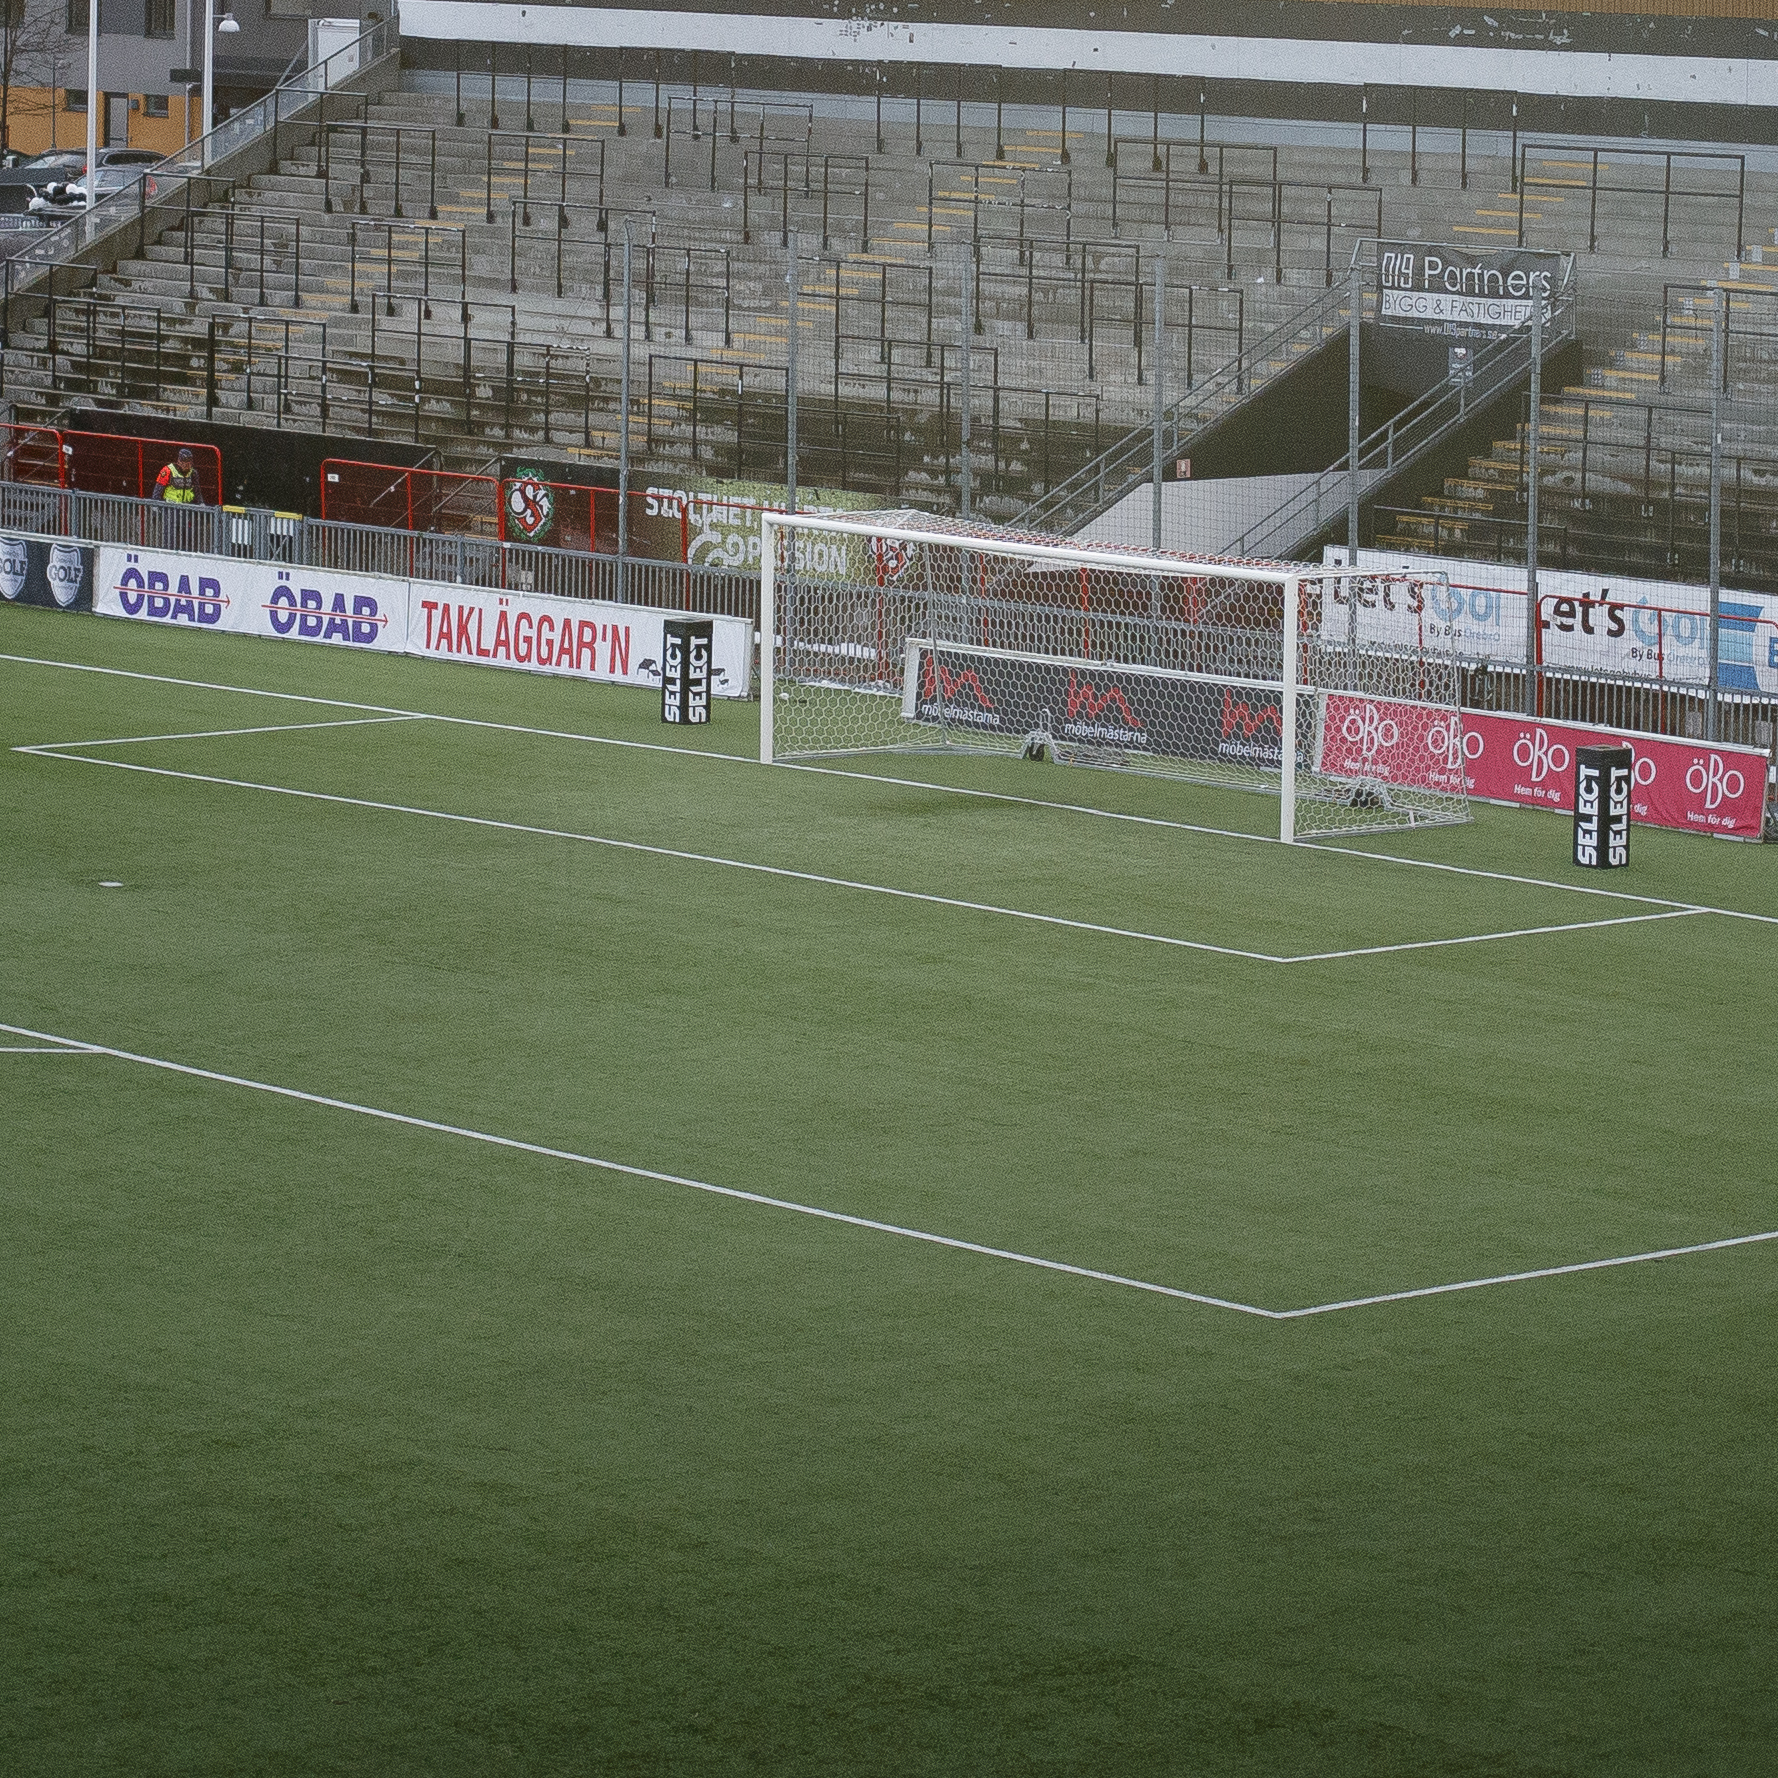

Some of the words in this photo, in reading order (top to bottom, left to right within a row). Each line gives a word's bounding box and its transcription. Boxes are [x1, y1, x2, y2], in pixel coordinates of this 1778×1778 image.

[1425, 256, 1551, 298] Partners
[1383, 292, 1428, 314] BYGG
[1434, 300, 1445, 315] &
[1450, 301, 1551, 323] FASTIGHETR
[48, 563, 83, 583] GOLF
[117, 554, 223, 624] ÖBAB
[269, 571, 380, 645] ÖBAB
[421, 597, 631, 677] TAKLÄGGAR'N
[1630, 647, 1644, 662] By
[664, 636, 682, 722] SELECT
[688, 635, 710, 723] SELECT
[1064, 722, 1148, 744] möbelmästarna
[1514, 783, 1532, 797] Hem
[1533, 784, 1546, 799] för
[1547, 788, 1561, 802] dig
[1634, 803, 1648, 816] dig
[1577, 764, 1600, 866] SELECT
[1608, 766, 1629, 867] SELECT
[1687, 810, 1705, 823] Hem
[1706, 812, 1720, 826] för
[1722, 815, 1737, 829] dig
